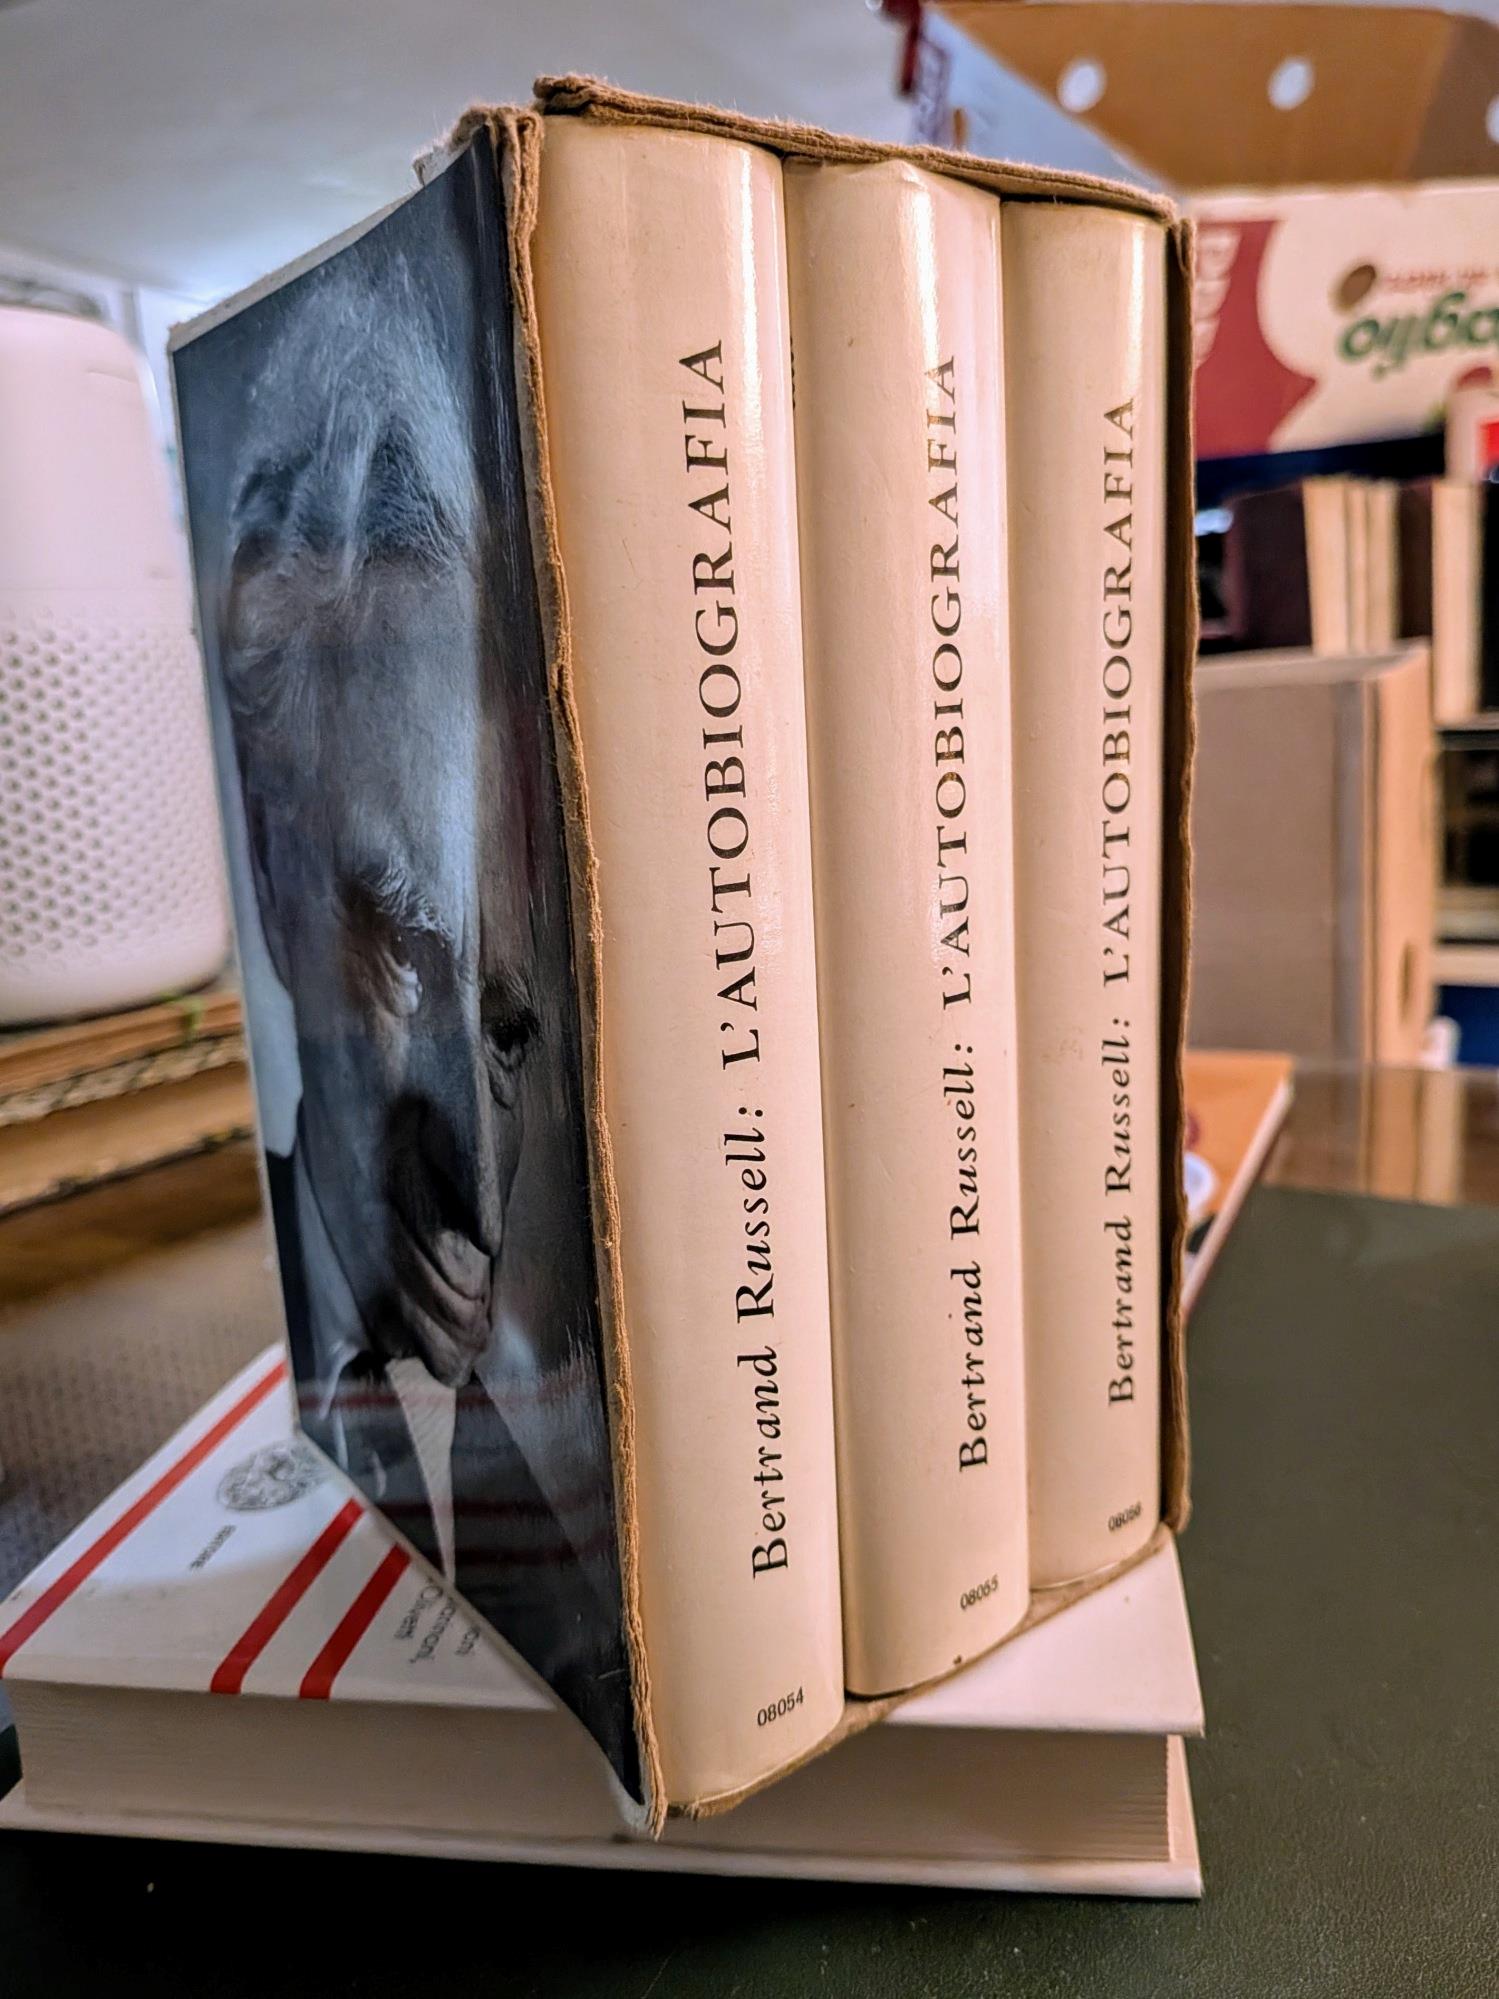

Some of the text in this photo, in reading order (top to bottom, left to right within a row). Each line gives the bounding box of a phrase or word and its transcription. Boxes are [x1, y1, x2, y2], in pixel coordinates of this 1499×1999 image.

[678, 339, 789, 1580] Bertrand Russell: L'AUTOBIOGRAFIA
[924, 355, 989, 1473] Bertrand Russell: L'AUTOBIOGRAFIA
[1100, 397, 1135, 1406] Bertrand Russell: L'AUTOBIOGRAFIA
[756, 1685, 806, 1728] 08054
